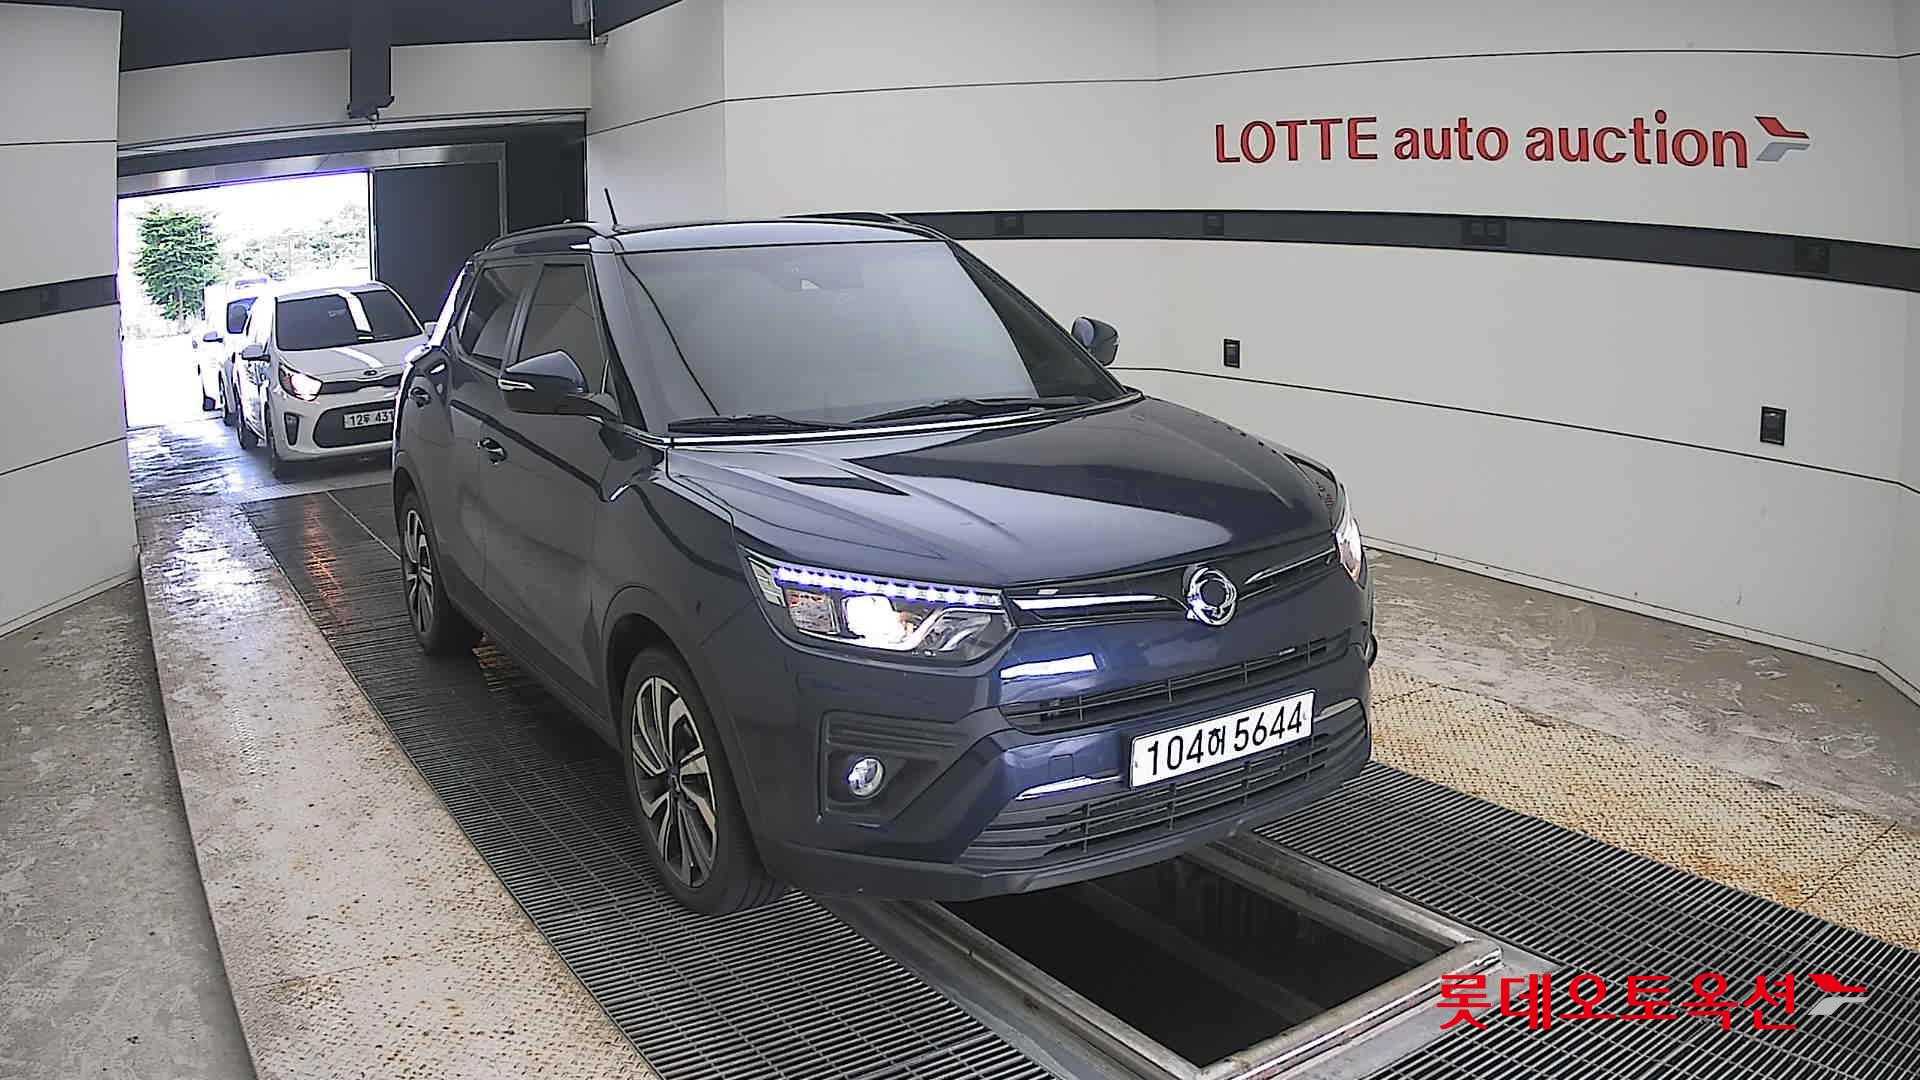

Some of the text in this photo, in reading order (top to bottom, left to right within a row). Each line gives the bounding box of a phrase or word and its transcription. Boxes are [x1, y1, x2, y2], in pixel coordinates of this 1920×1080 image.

[1215, 110, 1749, 168] LOTTE auto auction
[1147, 701, 1303, 776] 104허 5644
